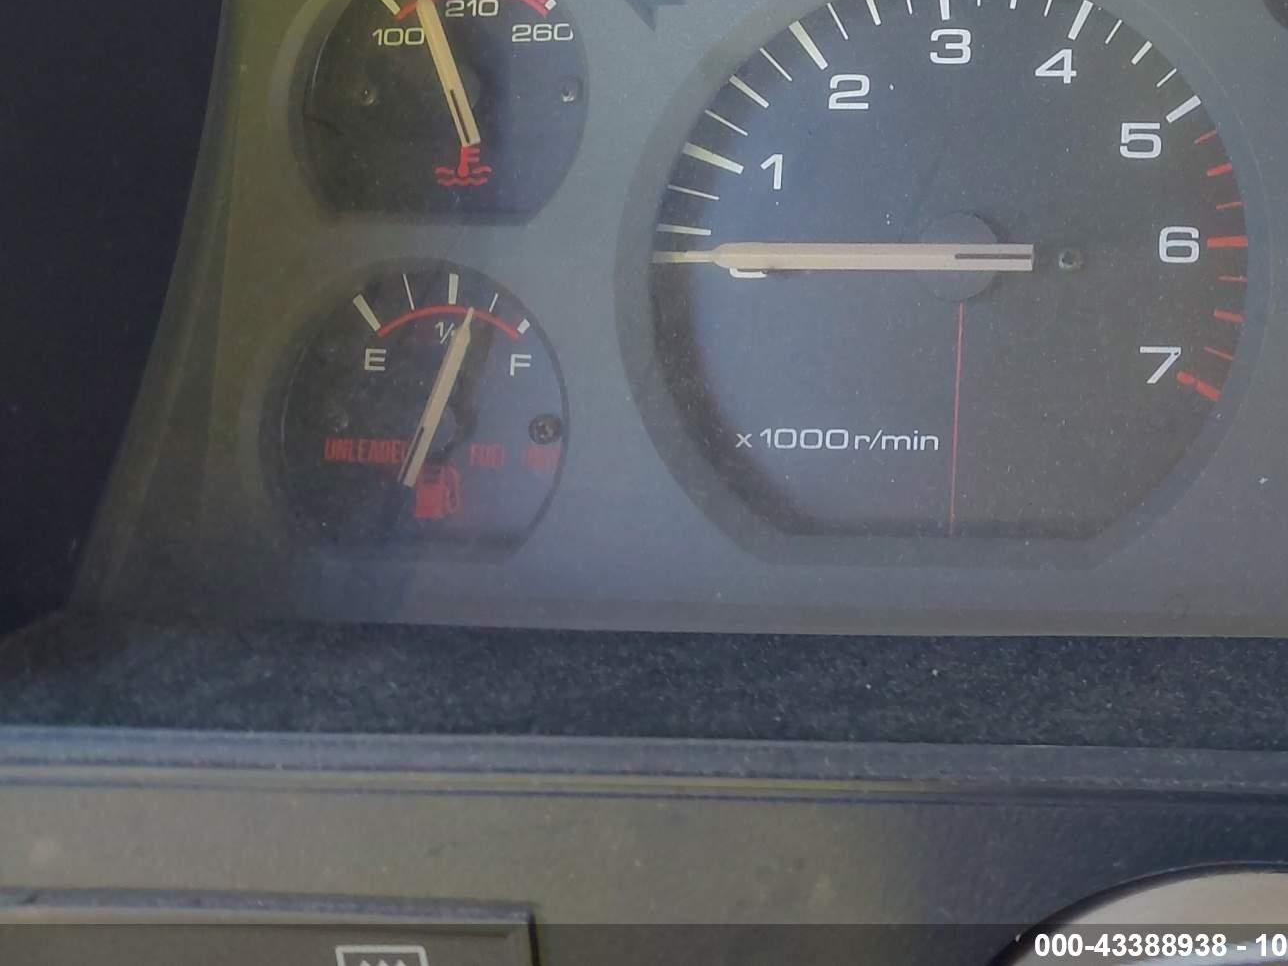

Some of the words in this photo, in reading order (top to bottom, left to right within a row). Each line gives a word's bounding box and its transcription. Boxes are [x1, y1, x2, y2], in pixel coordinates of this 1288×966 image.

[445, 0, 499, 18] 210
[372, 28, 425, 46] 100
[511, 23, 574, 42] 260
[929, 28, 972, 64] 3
[1035, 49, 1077, 84] 4
[828, 74, 870, 110] 2
[1120, 122, 1162, 159] 5
[761, 154, 783, 190] 1
[1158, 226, 1200, 263] 6
[364, 348, 387, 371] E
[509, 354, 532, 376] F
[1139, 346, 1181, 384] 7
[854, 429, 939, 451] r/min
